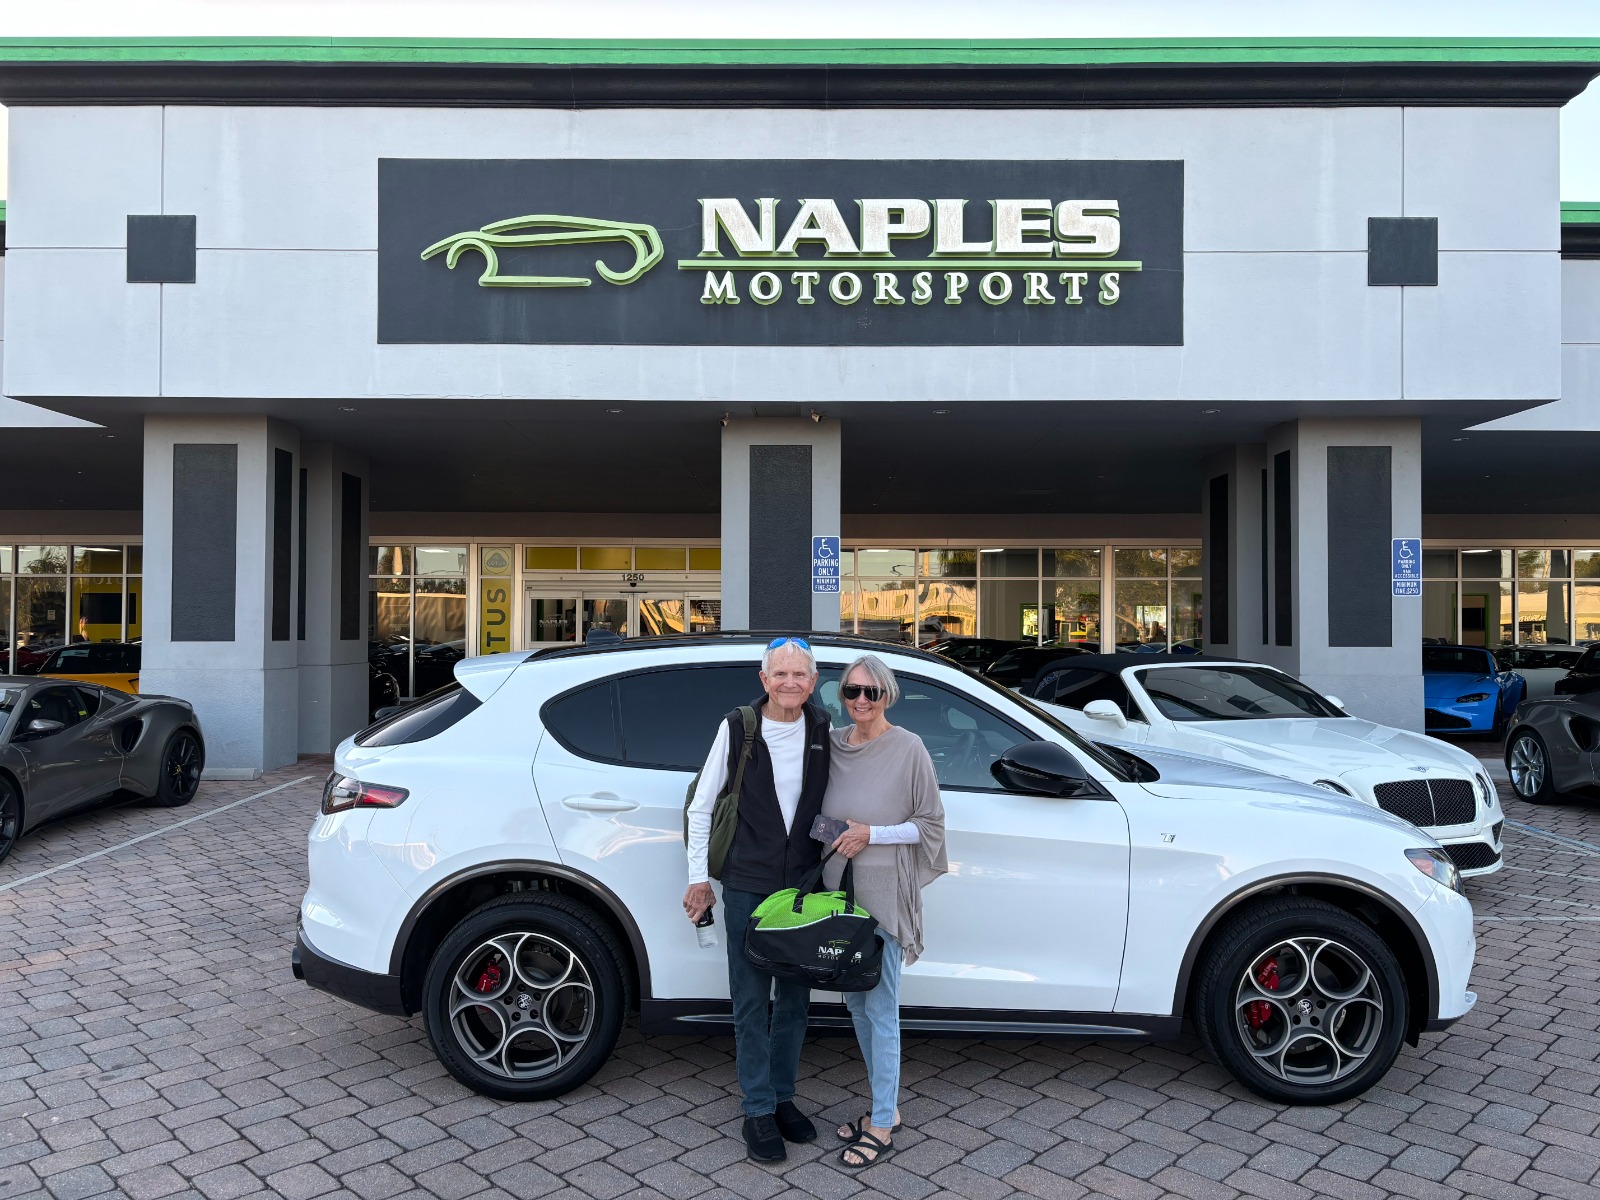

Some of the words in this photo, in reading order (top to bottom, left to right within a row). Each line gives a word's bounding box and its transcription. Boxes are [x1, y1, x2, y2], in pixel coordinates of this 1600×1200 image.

[697, 198, 1120, 257] NAPLES
[700, 270, 1121, 305] MOTORSPORTS
[814, 558, 838, 566] PARKING
[622, 573, 645, 581] 1250
[818, 946, 862, 959] NAPS
